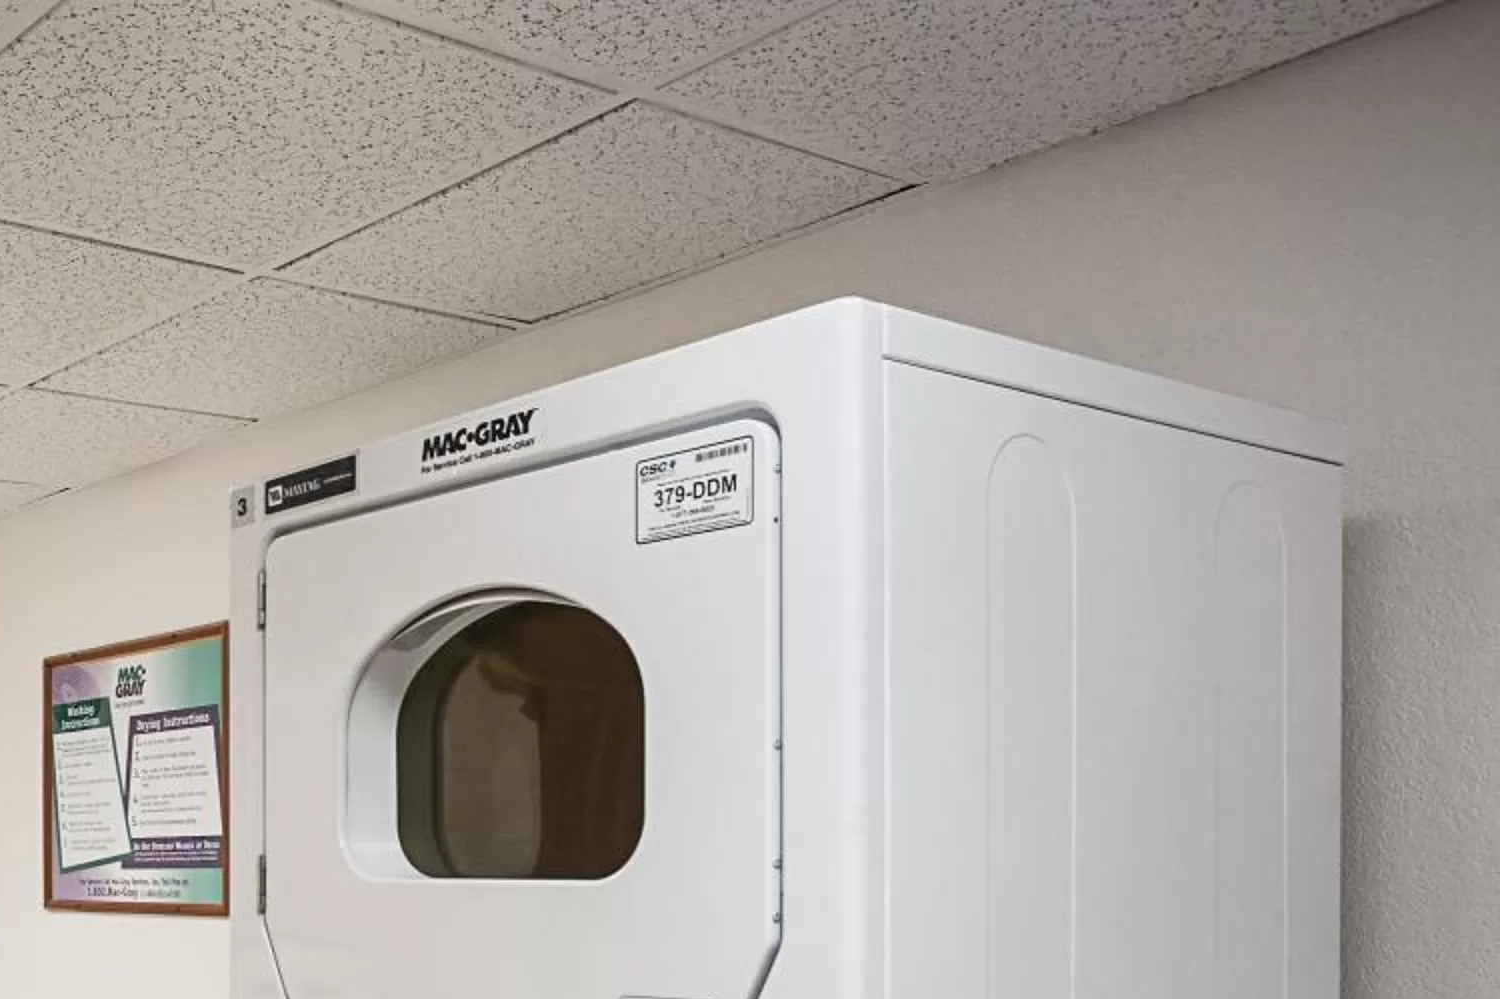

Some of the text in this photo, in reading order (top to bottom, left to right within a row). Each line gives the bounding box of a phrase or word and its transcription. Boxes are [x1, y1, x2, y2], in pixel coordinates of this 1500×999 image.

[640, 461, 667, 476] CSC
[653, 473, 737, 507] 379-DDM
[237, 497, 247, 516] 3
[115, 679, 146, 698] GRAY
